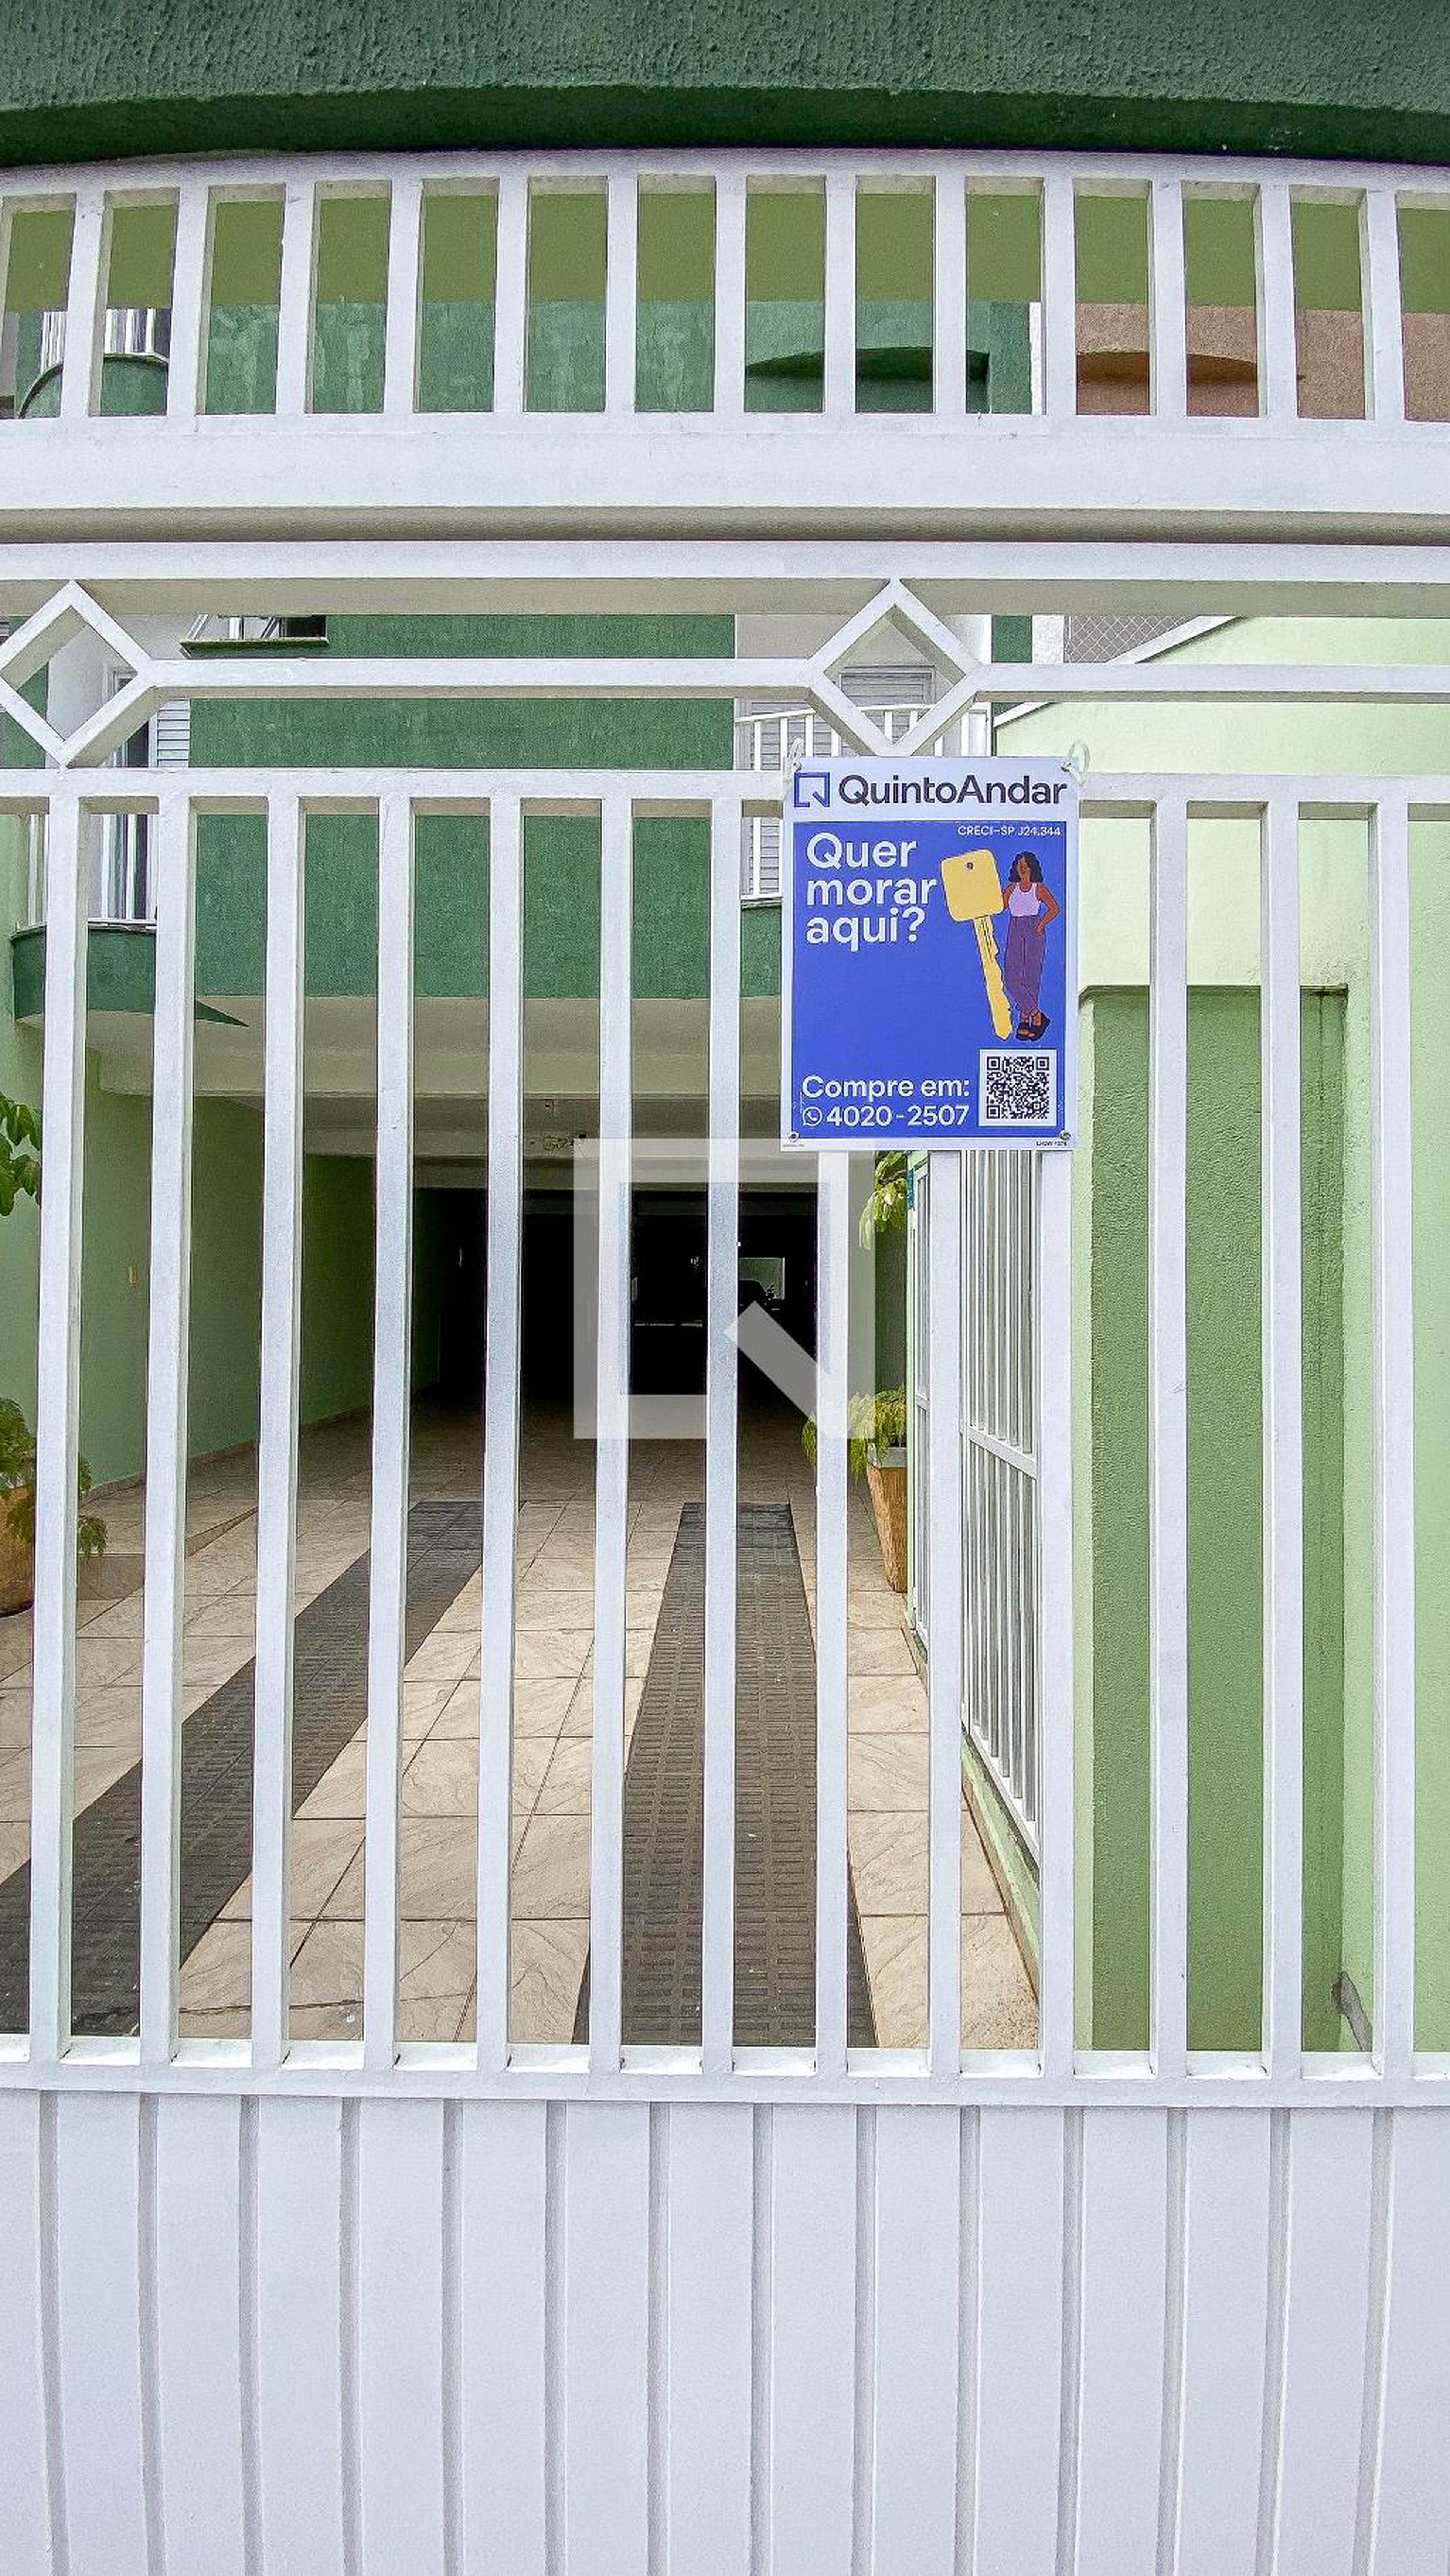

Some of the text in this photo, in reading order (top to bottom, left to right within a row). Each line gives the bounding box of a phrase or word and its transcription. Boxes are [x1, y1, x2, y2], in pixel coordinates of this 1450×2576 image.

[838, 774, 1067, 806] QuintoAndar
[958, 826, 1015, 837] CRECI-SP
[807, 832, 916, 869] Quer
[807, 876, 936, 906] morar
[807, 906, 926, 952] aqui?
[802, 1075, 969, 1101] Compre em:
